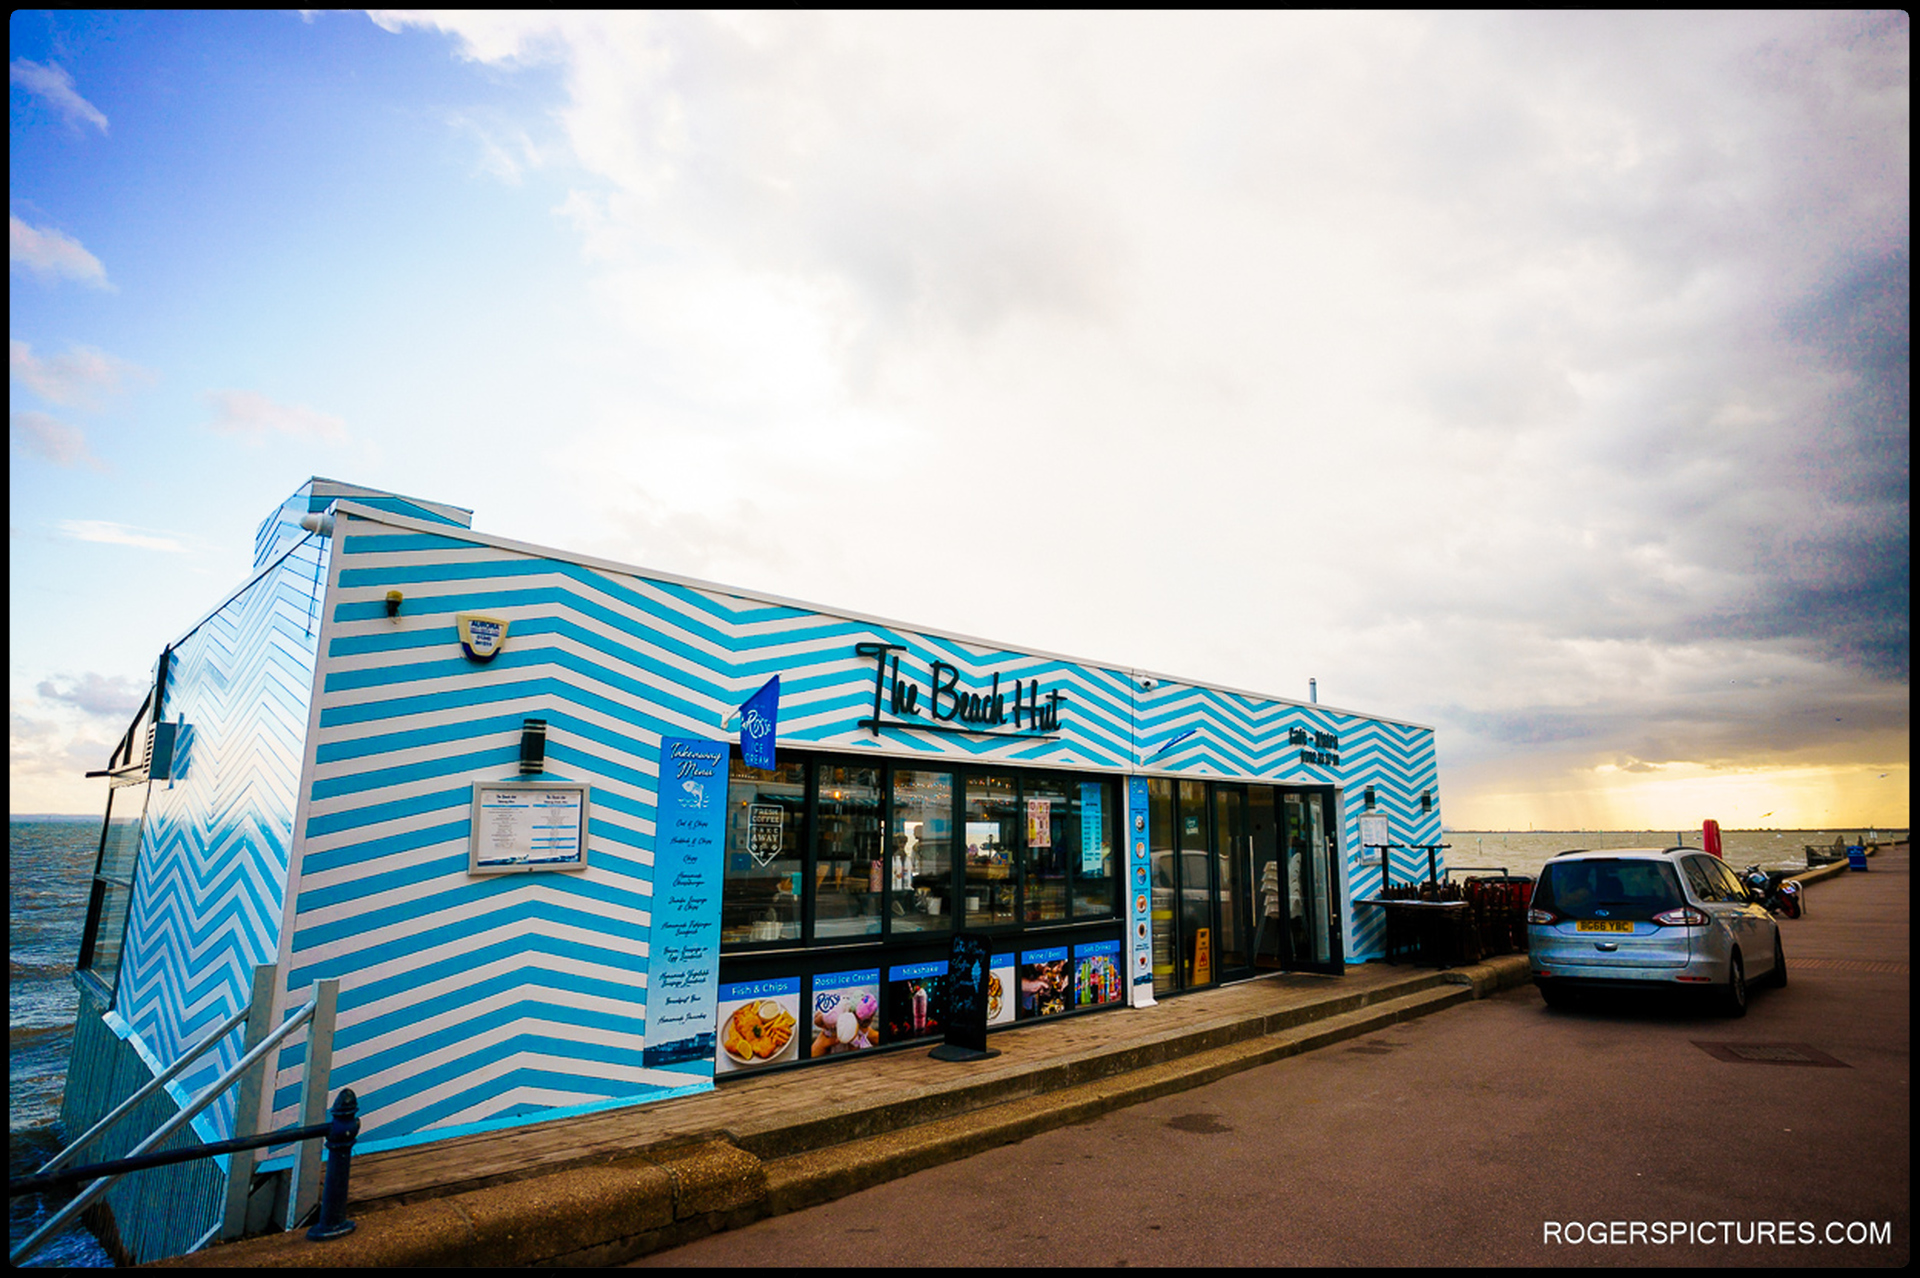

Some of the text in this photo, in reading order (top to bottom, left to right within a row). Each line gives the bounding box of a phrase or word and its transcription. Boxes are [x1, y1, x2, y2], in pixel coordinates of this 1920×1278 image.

[855, 642, 1068, 737] The Beach Hut
[671, 742, 721, 766] Takeaway
[752, 741, 764, 754] ICE
[745, 753, 769, 766] CREAM
[677, 760, 714, 779] Menu
[752, 815, 780, 823] COFFEE
[751, 834, 779, 842] AWAY
[1028, 952, 1044, 960] Wine
[1048, 950, 1062, 959] Beer
[1083, 944, 1112, 954] Soft Drinks
[902, 964, 939, 976] Milkshake
[815, 973, 878, 987] Rossi Ice Cream
[731, 981, 788, 996] Fish & Chips
